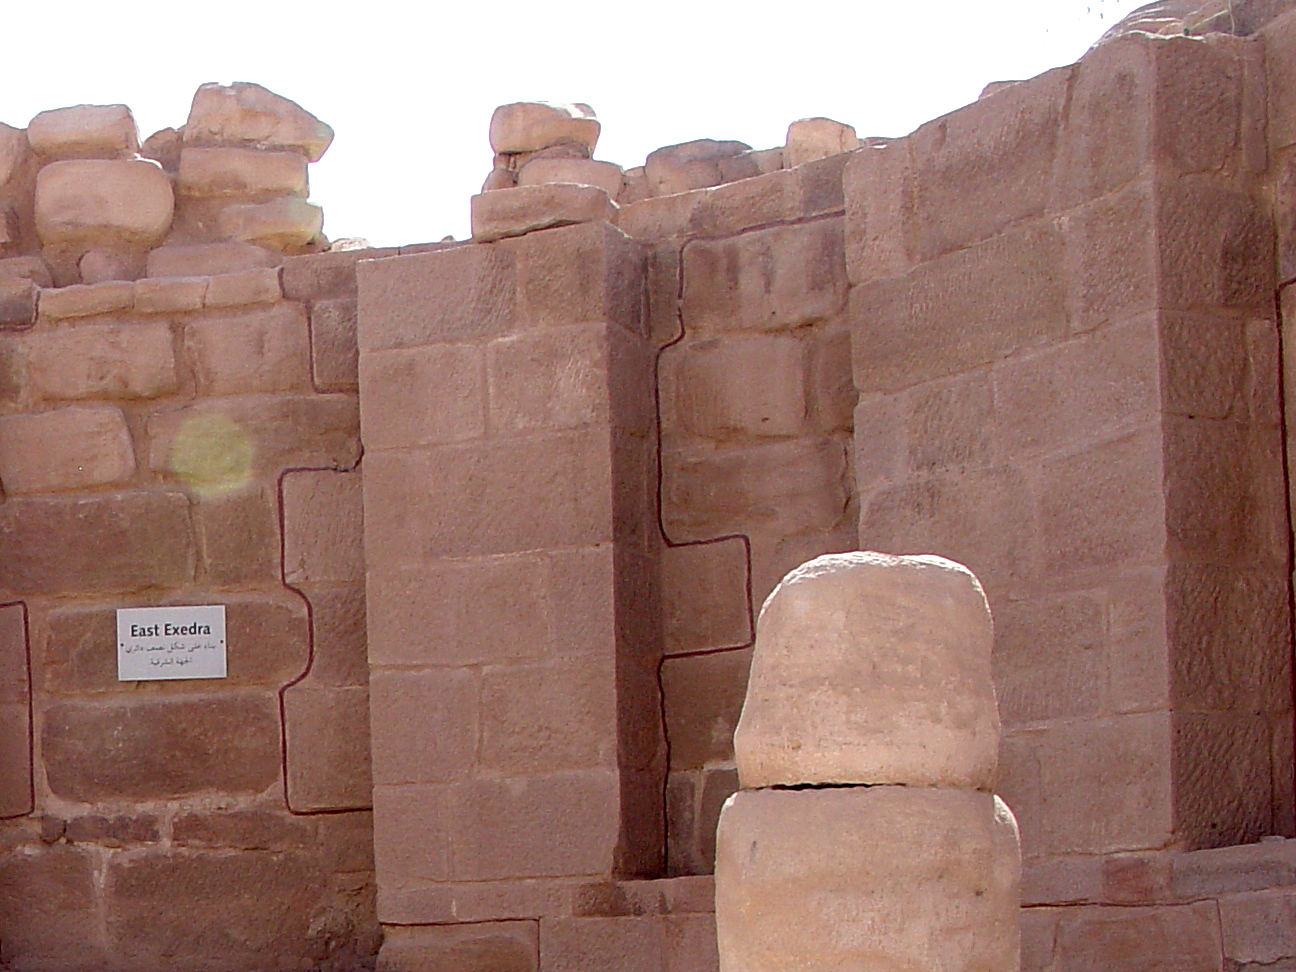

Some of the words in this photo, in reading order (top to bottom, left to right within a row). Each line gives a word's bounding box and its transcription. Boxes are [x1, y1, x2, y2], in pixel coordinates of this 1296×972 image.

[131, 624, 160, 637] East
[164, 622, 211, 636] Exedra
[167, 641, 185, 653] شكل
[188, 643, 201, 653] على
